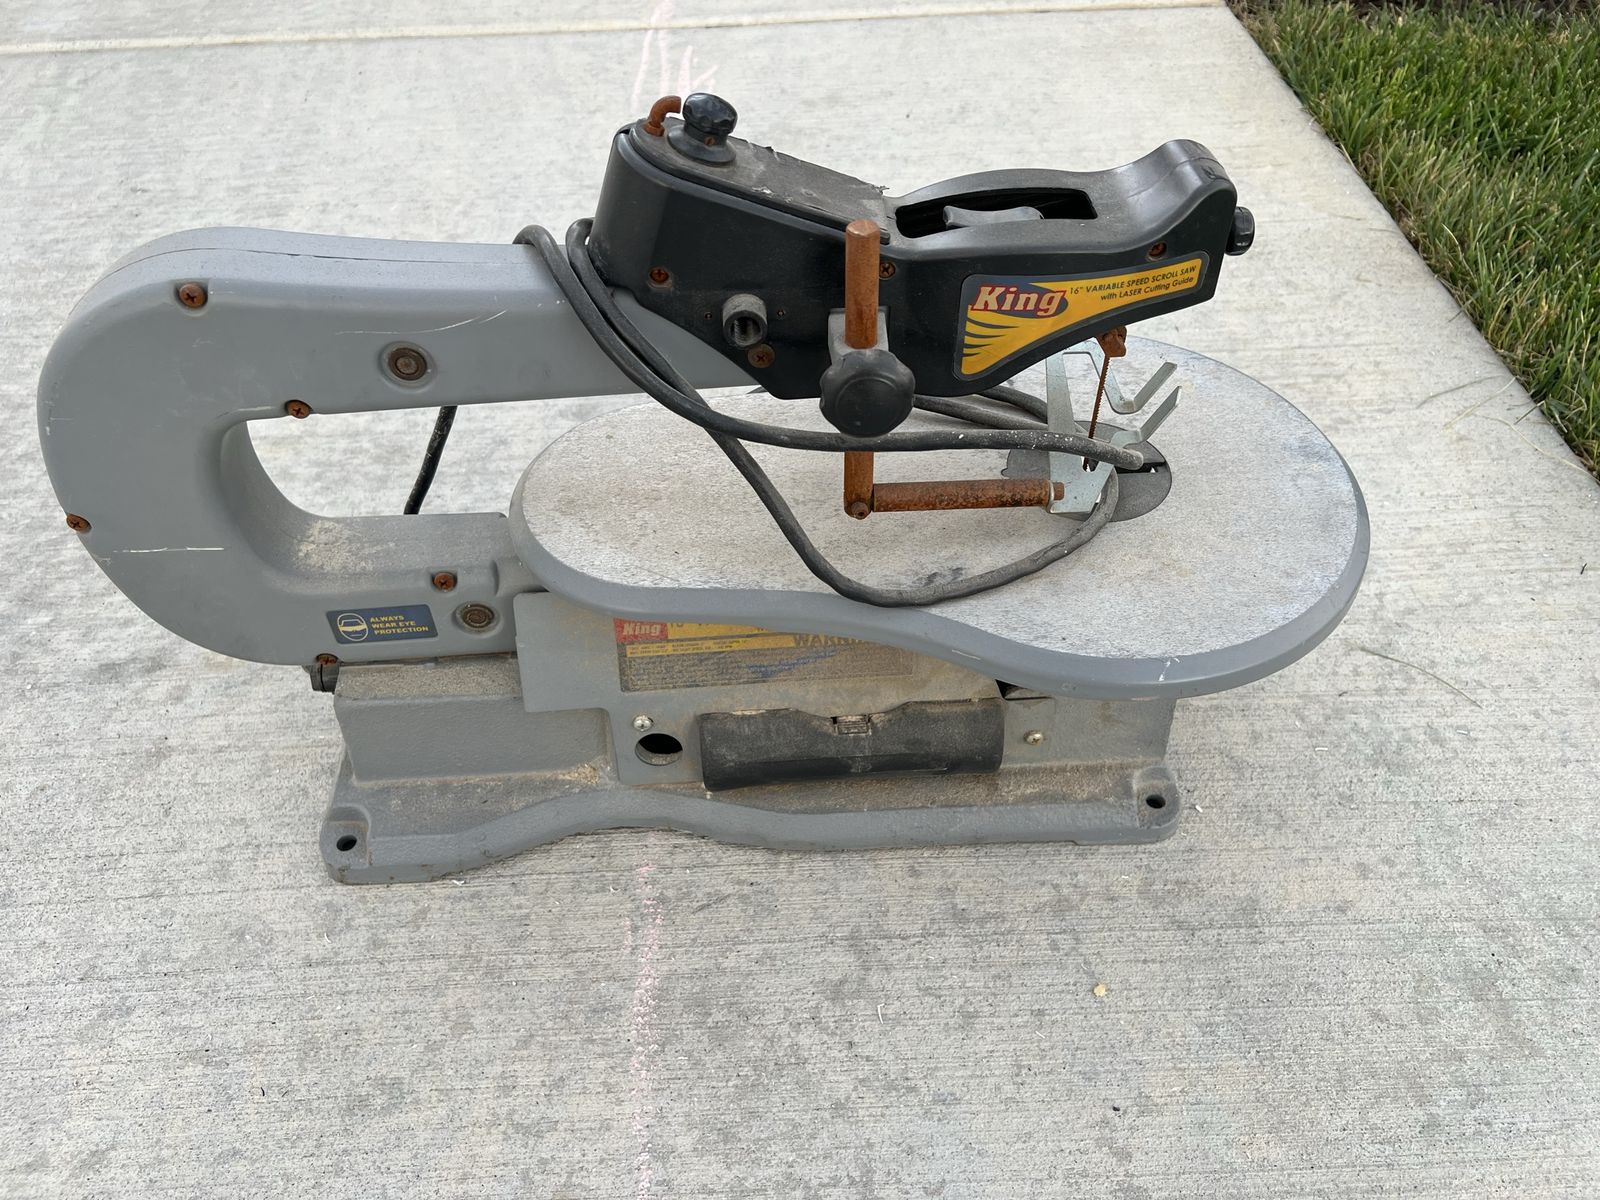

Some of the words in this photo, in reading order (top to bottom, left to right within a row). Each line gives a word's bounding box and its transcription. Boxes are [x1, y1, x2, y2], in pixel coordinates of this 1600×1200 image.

[1069, 286, 1083, 295] 16"
[1086, 280, 1125, 293] VARIABLE
[1126, 276, 1150, 287] SPEED
[1151, 271, 1179, 283] SCROLL
[1180, 265, 1197, 275] SAW
[1100, 291, 1117, 301] with
[1119, 287, 1142, 298] LASER
[1144, 281, 1171, 293] Cutting
[1172, 275, 1194, 287] Guide
[970, 285, 1066, 318] King
[370, 615, 405, 623] ALWAYS
[622, 622, 661, 636] King
[374, 626, 429, 635] PROTECTION
